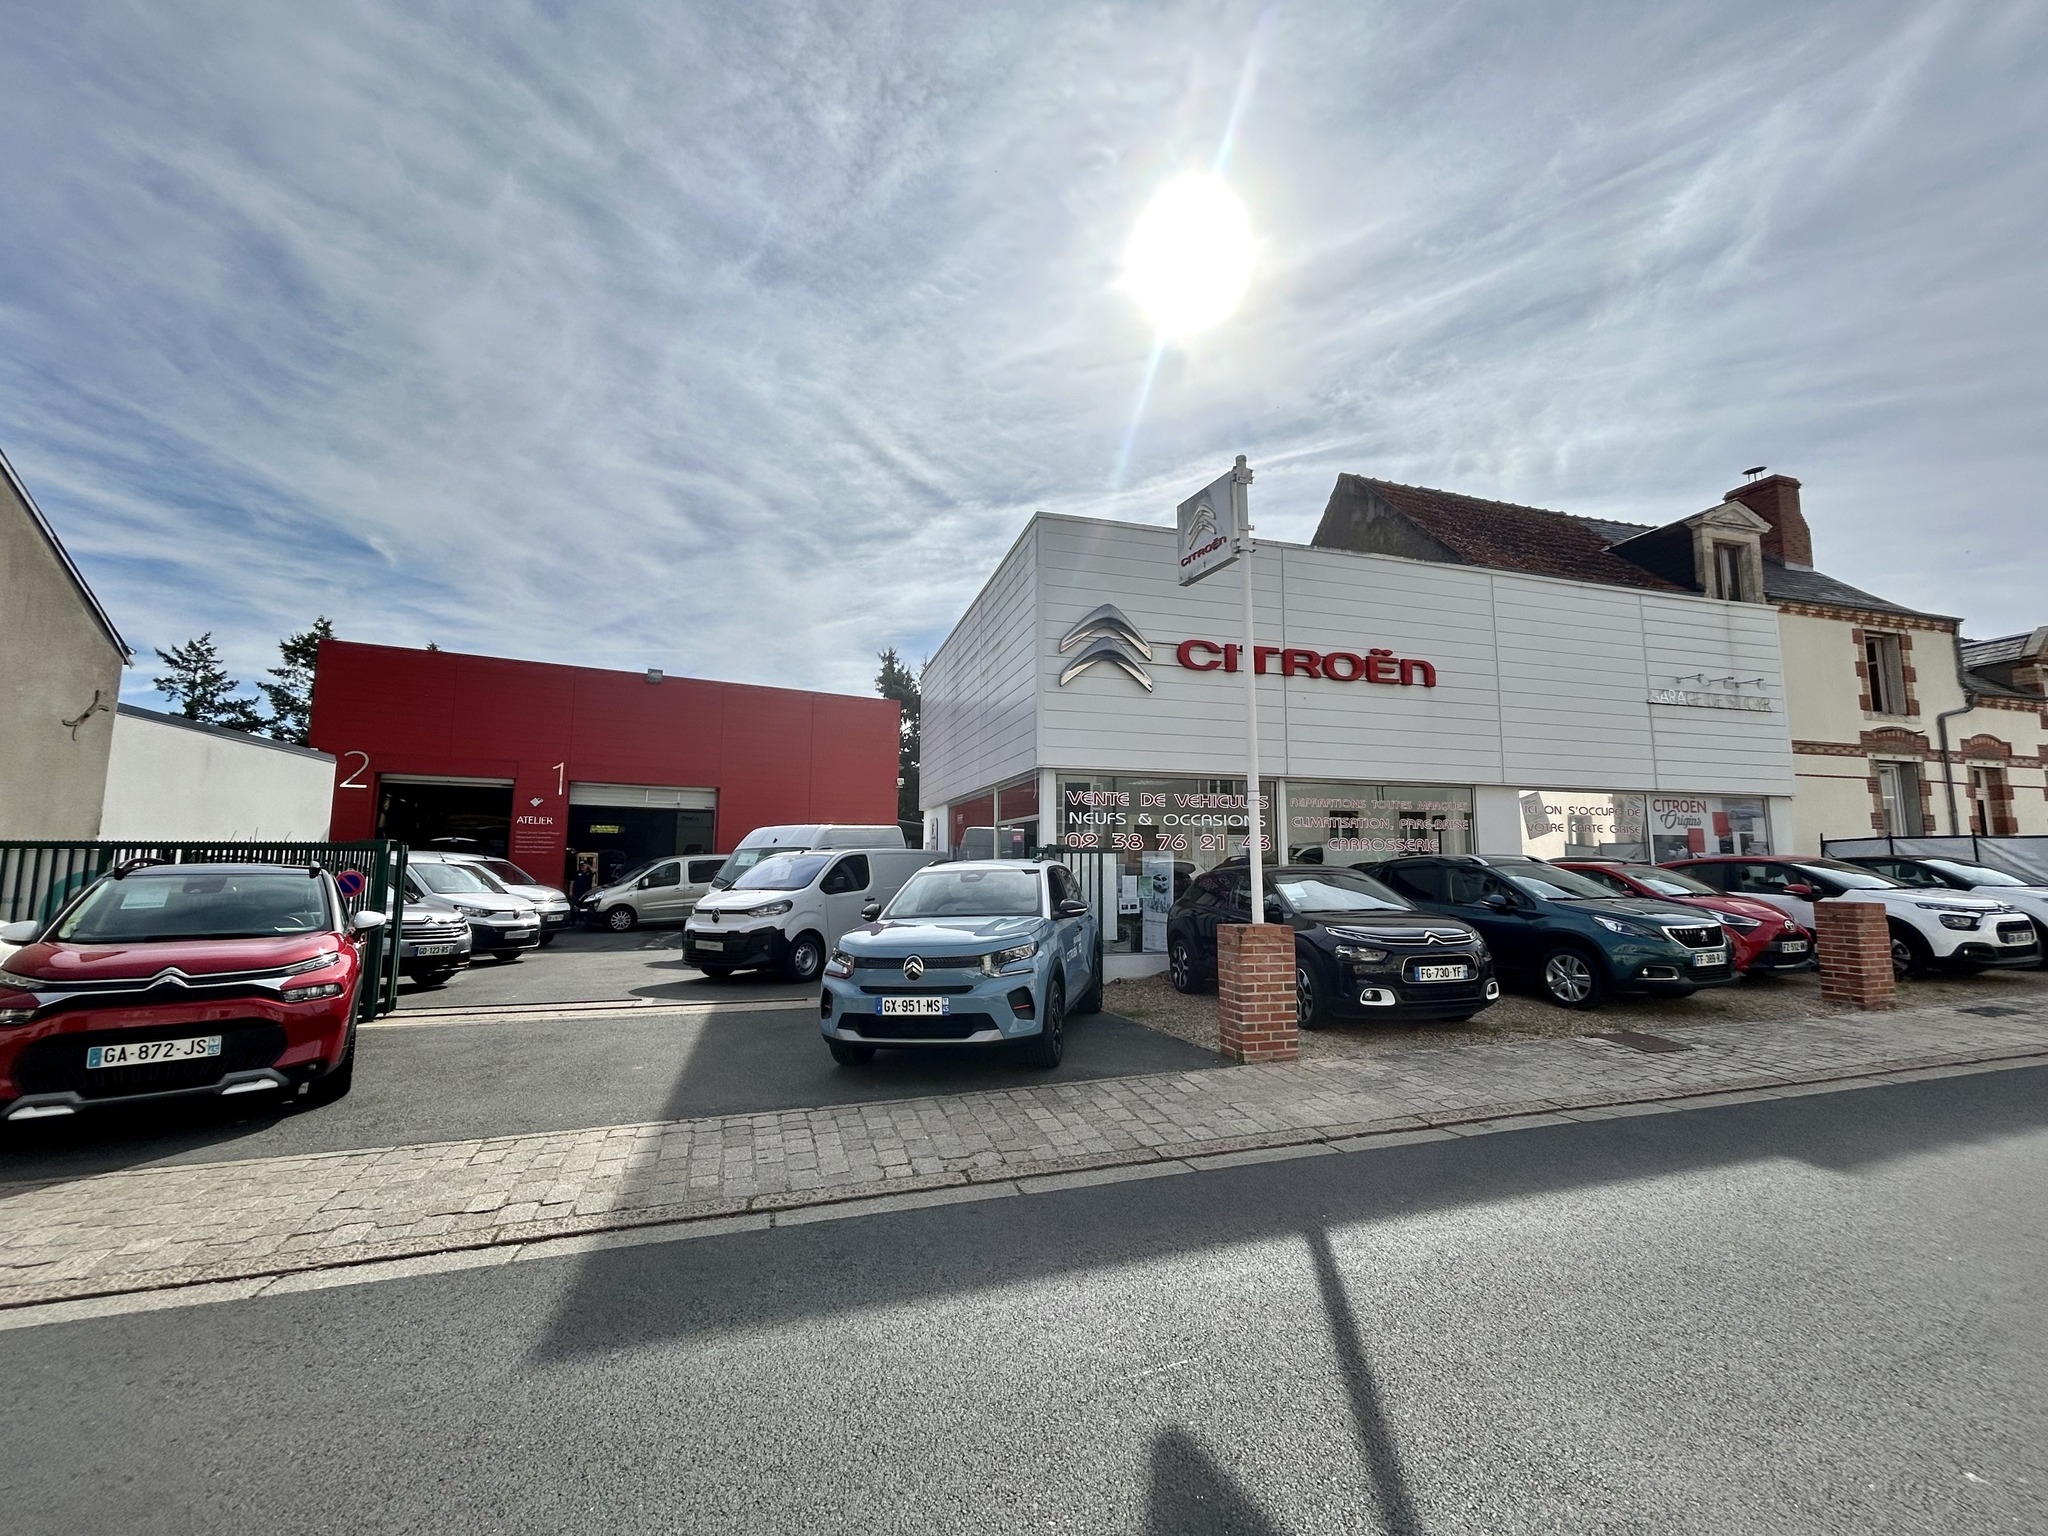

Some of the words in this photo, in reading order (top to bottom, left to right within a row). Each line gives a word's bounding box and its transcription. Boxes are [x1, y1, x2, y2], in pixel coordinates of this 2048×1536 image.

[339, 751, 370, 788] 2
[552, 762, 565, 796] 1
[1066, 791, 1130, 807] VENTE
[1140, 793, 1166, 808] DE
[1174, 794, 1269, 810] VEHICULS
[1371, 799, 1413, 811] TOUTES
[1524, 805, 1538, 814] ICI
[1544, 805, 1562, 815] ON
[1568, 806, 1622, 817] S'OCCUPE
[1627, 808, 1641, 817] DE
[516, 815, 553, 825] ATELIER
[1069, 811, 1127, 826] NEUFS
[1138, 813, 1153, 826] &
[1291, 817, 1395, 831] CLIMATISATION,
[1660, 810, 1702, 829] Origins
[1527, 823, 1565, 833] VOTRE
[1571, 824, 1604, 834] CARTE
[1609, 825, 1641, 834] GRISE
[1065, 833, 1099, 849] 02
[1111, 833, 1144, 850] 38
[1156, 834, 1188, 851] 76
[1200, 834, 1225, 851] 21
[1242, 835, 1271, 851] 43
[1327, 838, 1440, 852] CARROSSERIE
[1420, 966, 1462, 979] FG-730-YF
[884, 999, 941, 1013] GX-951-MS
[104, 1039, 207, 1063] GA-872-JS
